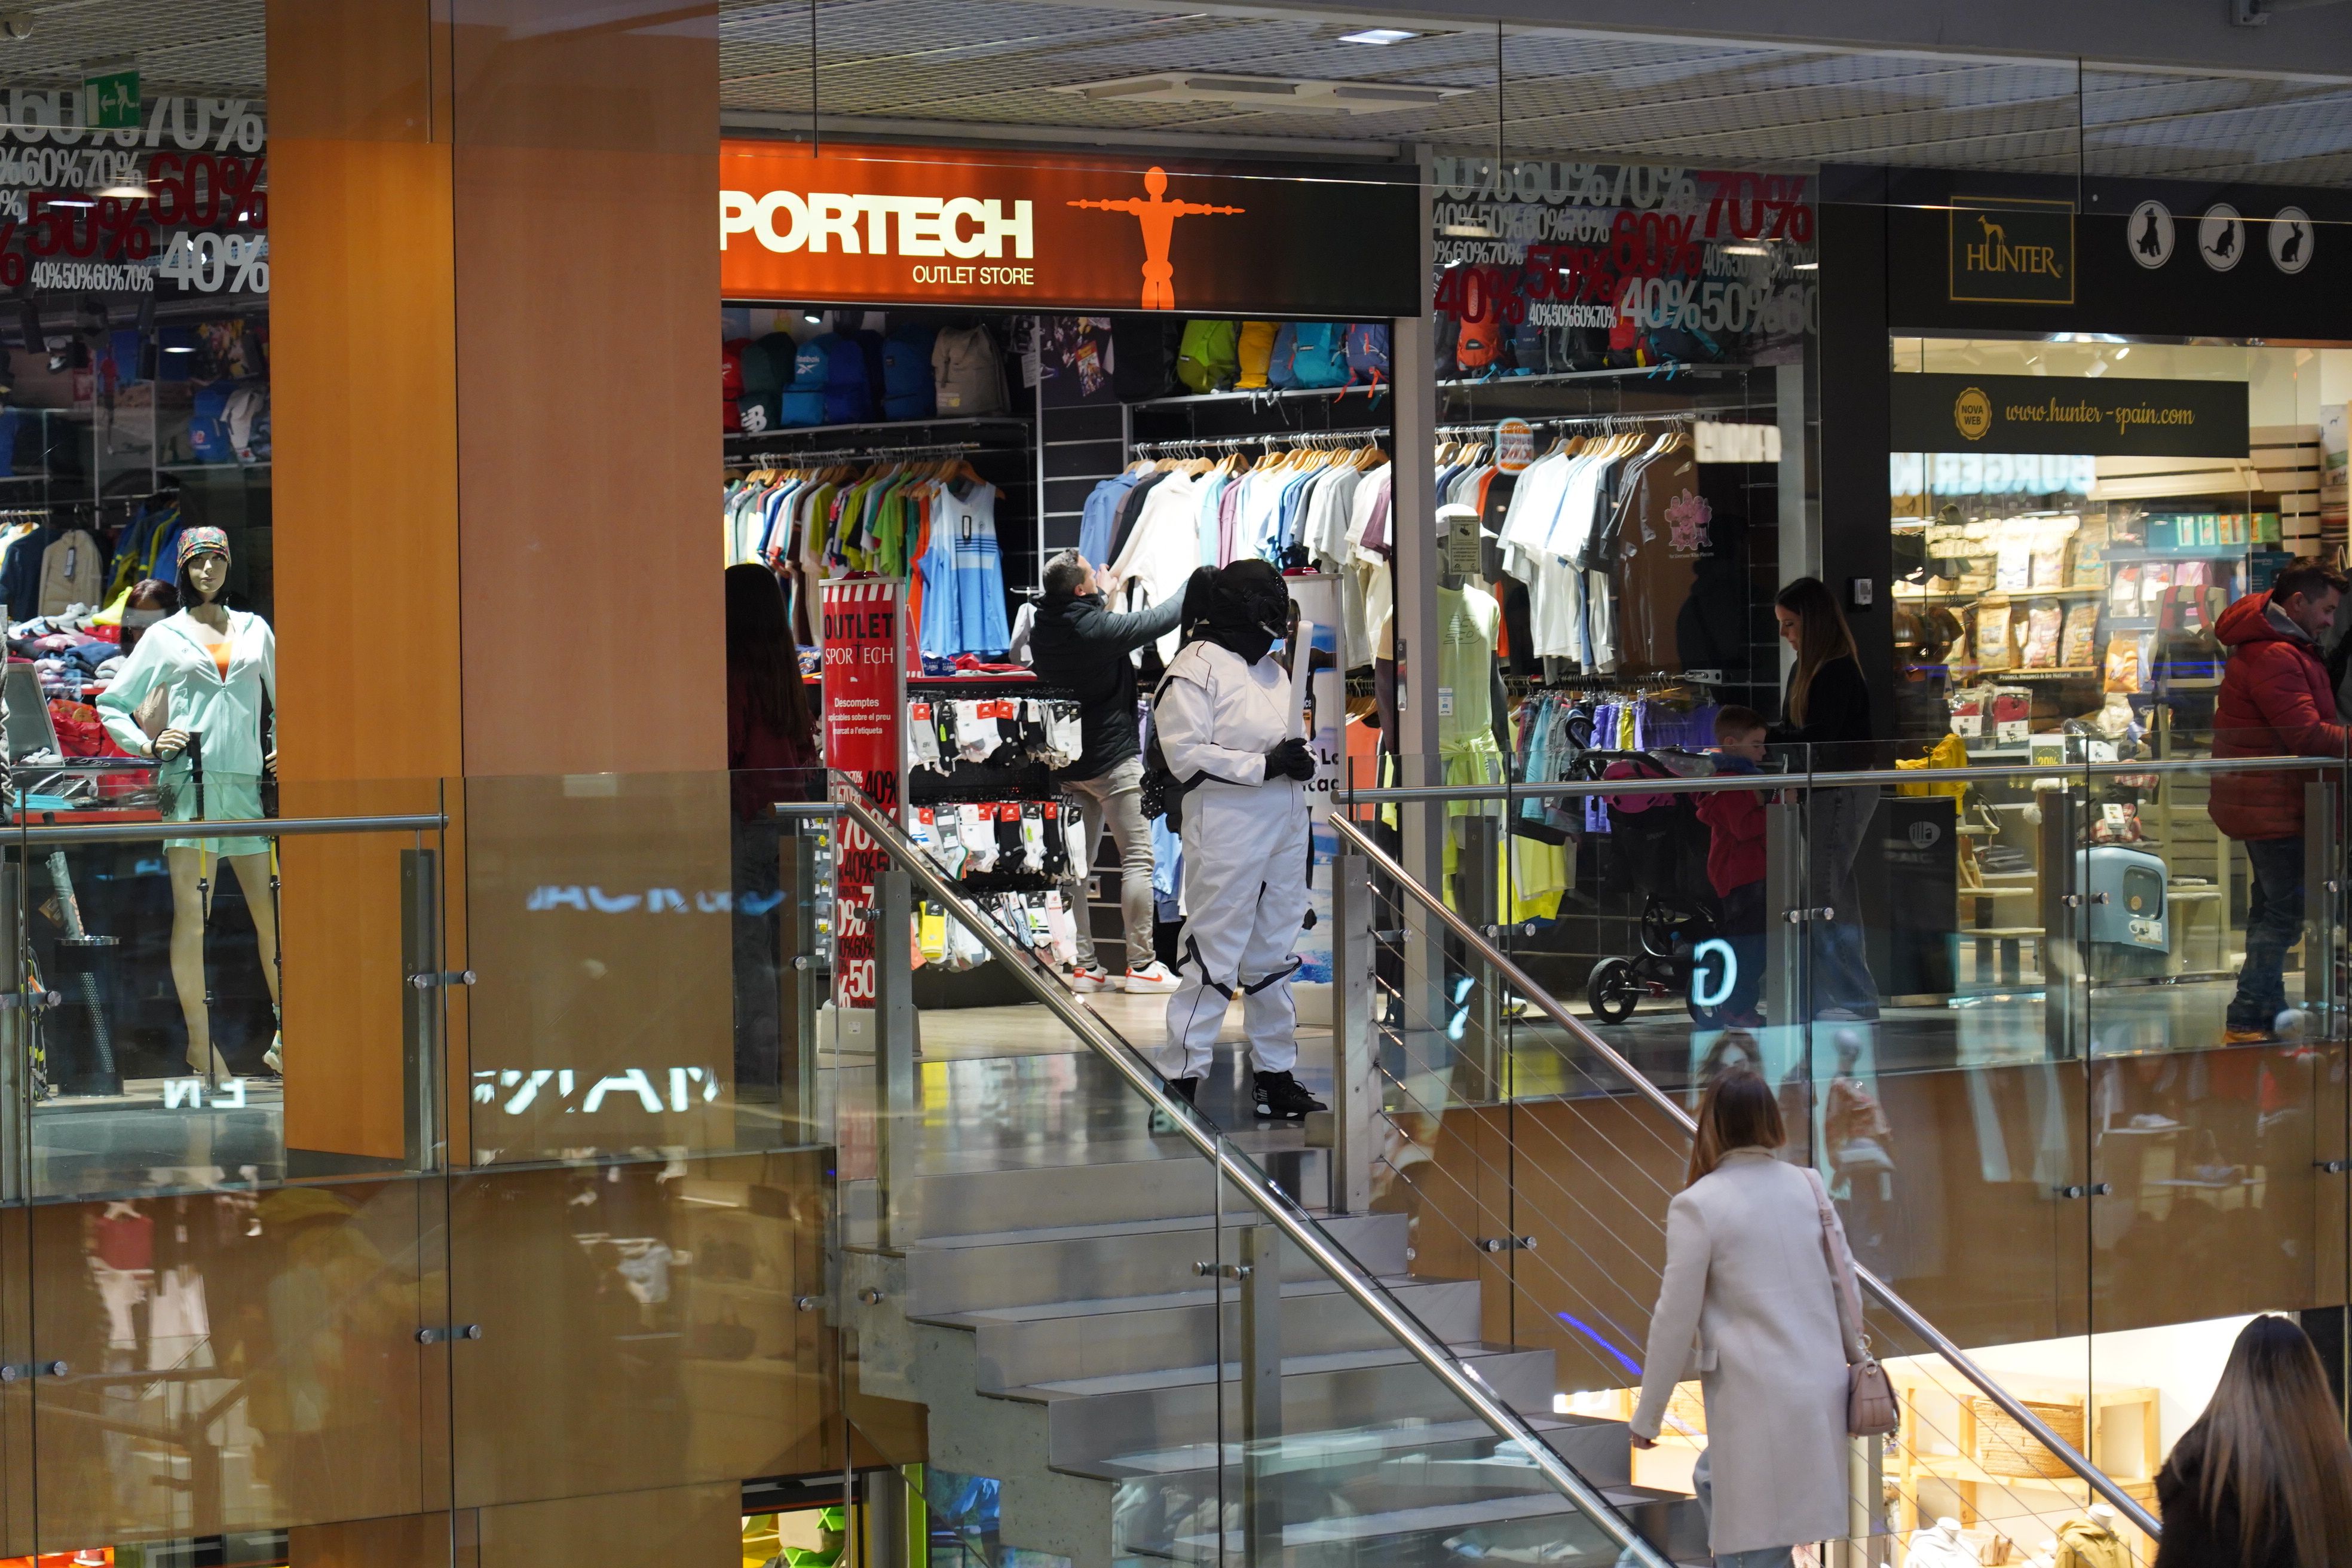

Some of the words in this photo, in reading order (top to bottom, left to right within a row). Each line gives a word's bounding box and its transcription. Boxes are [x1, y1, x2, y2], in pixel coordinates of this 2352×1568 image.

[148, 152, 268, 229] 60%
[1698, 170, 1813, 243] 70%
[27, 191, 151, 260] 50%
[719, 190, 1033, 259] PORTECH
[1613, 210, 1702, 277] 60%
[160, 231, 269, 293] 40%
[912, 265, 976, 284] OUTLET
[980, 267, 1034, 285] STORE
[1526, 245, 1613, 302] 50%
[1966, 243, 2062, 279] HUNTER
[1435, 268, 1525, 325] 40%
[1961, 405, 1984, 416] NOVA
[1964, 415, 1982, 426] WEB
[824, 613, 893, 640] OUTLET
[834, 697, 879, 708] Descomptes
